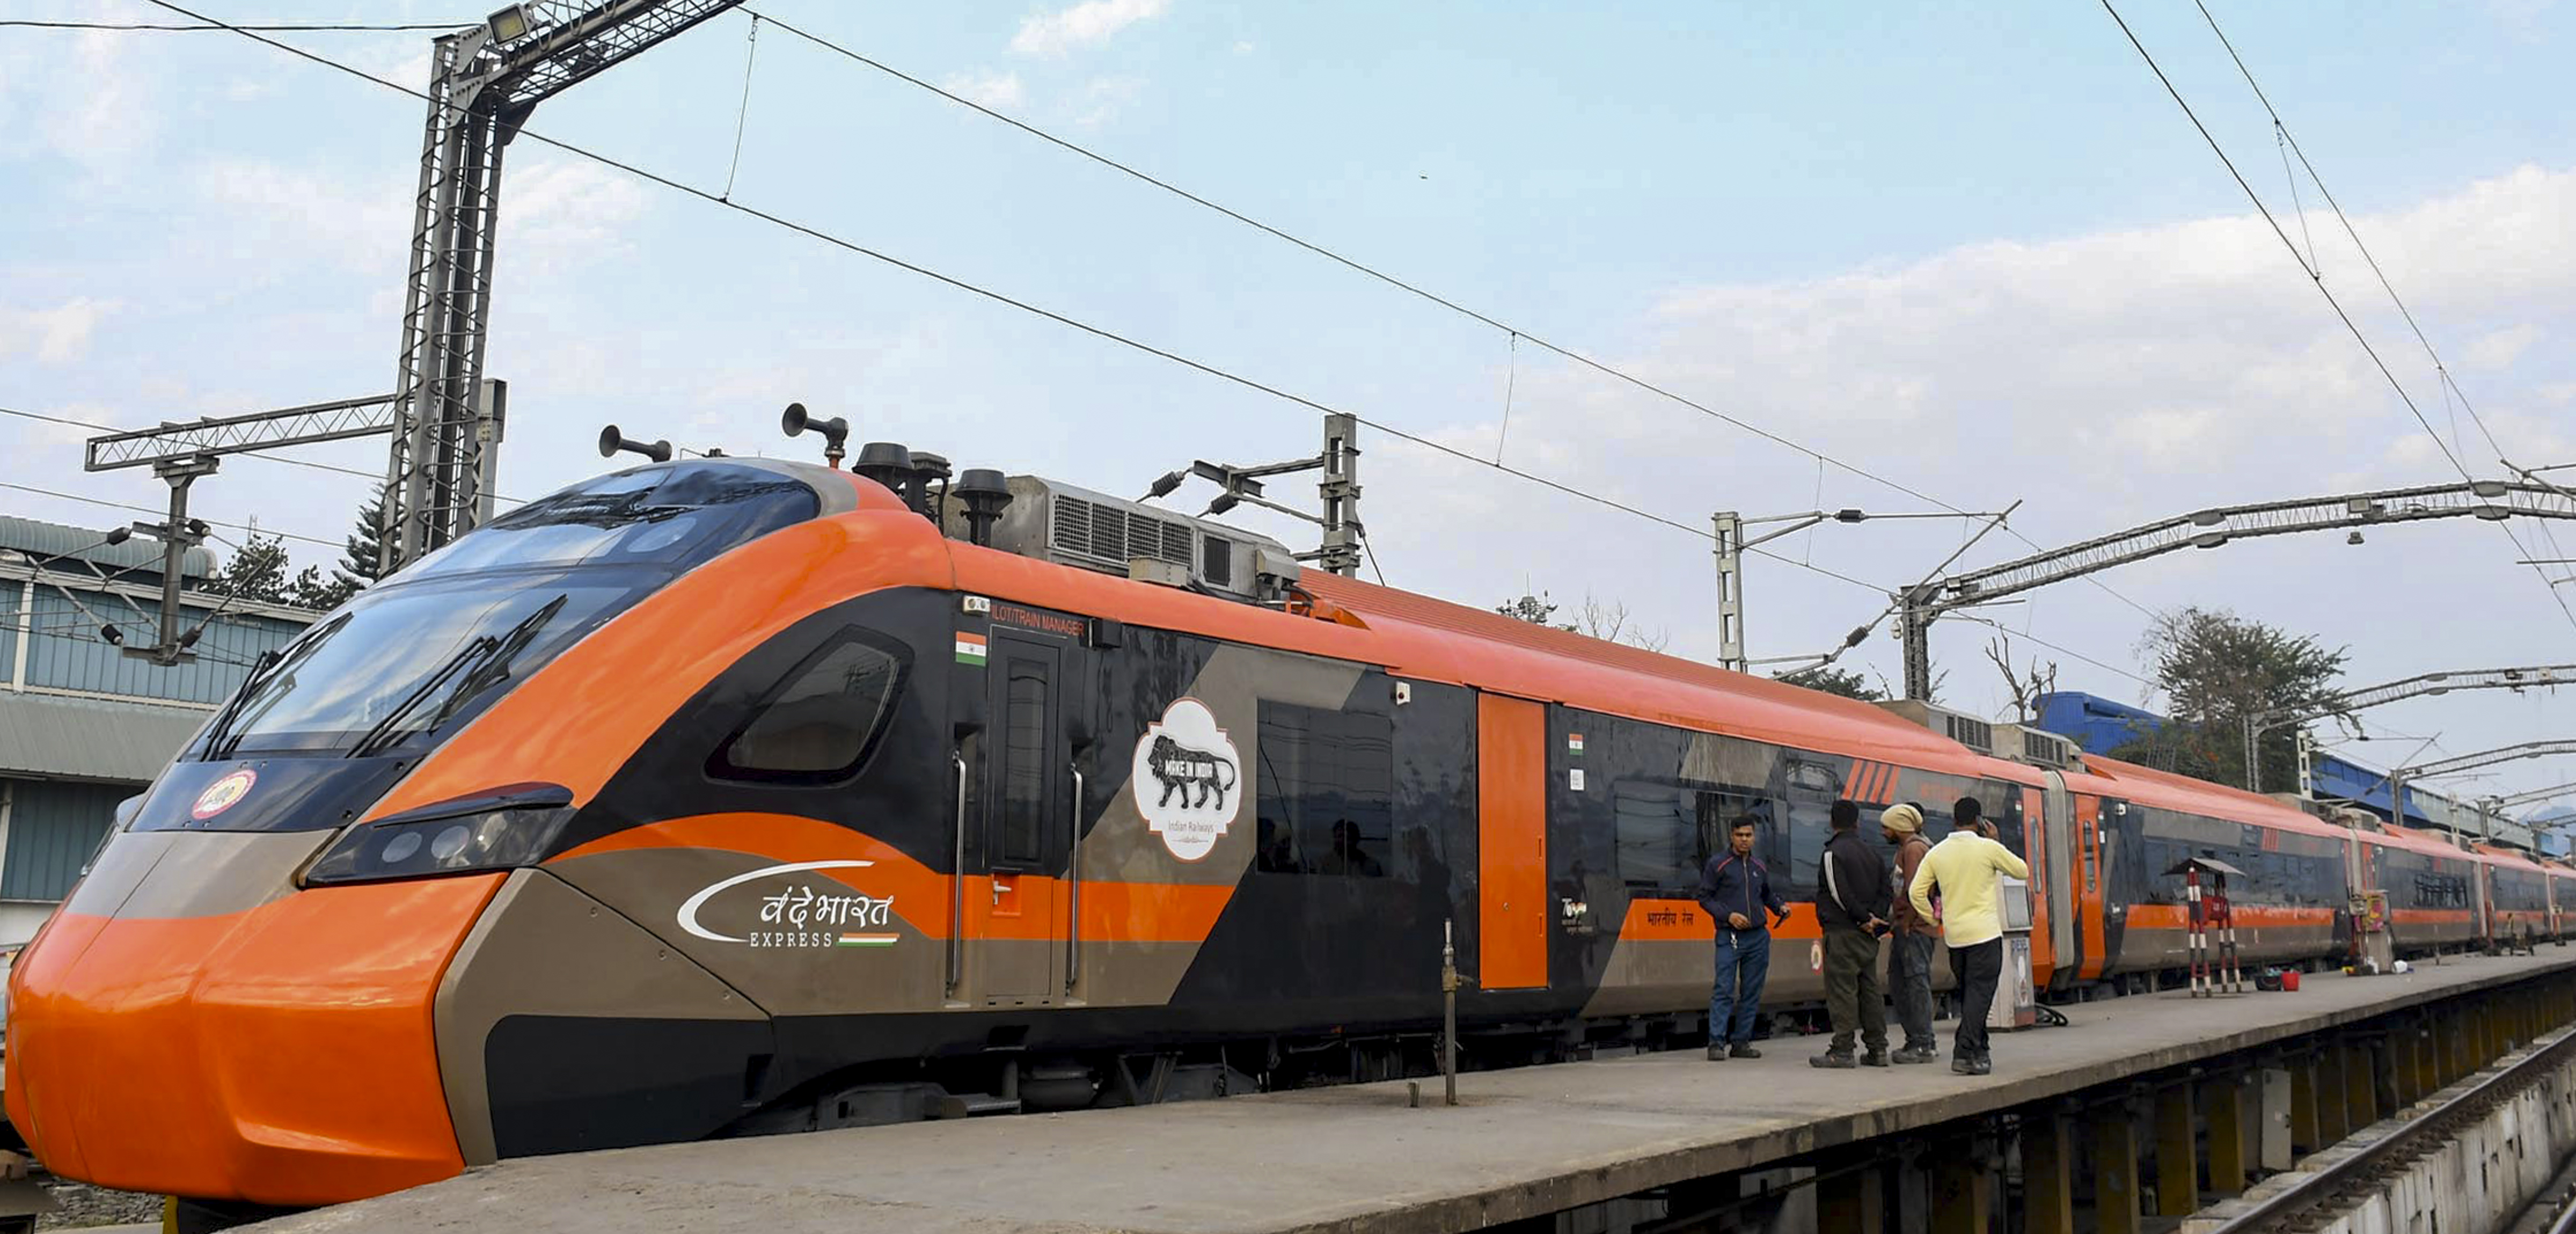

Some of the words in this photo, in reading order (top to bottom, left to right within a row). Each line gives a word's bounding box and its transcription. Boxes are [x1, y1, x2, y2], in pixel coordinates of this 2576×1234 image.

[991, 604, 1040, 627] ILOT/TRAIN
[1042, 615, 1085, 636] MANAGER
[1165, 759, 1185, 777] MAKE
[1186, 761, 1194, 777] IN
[1195, 762, 1213, 778] INDIA
[1169, 820, 1188, 831] Indian
[1188, 821, 1214, 835] Railways
[815, 895, 894, 928] भारत
[1647, 907, 1677, 927] भारतीय
[750, 932, 832, 947] EXPRESS
